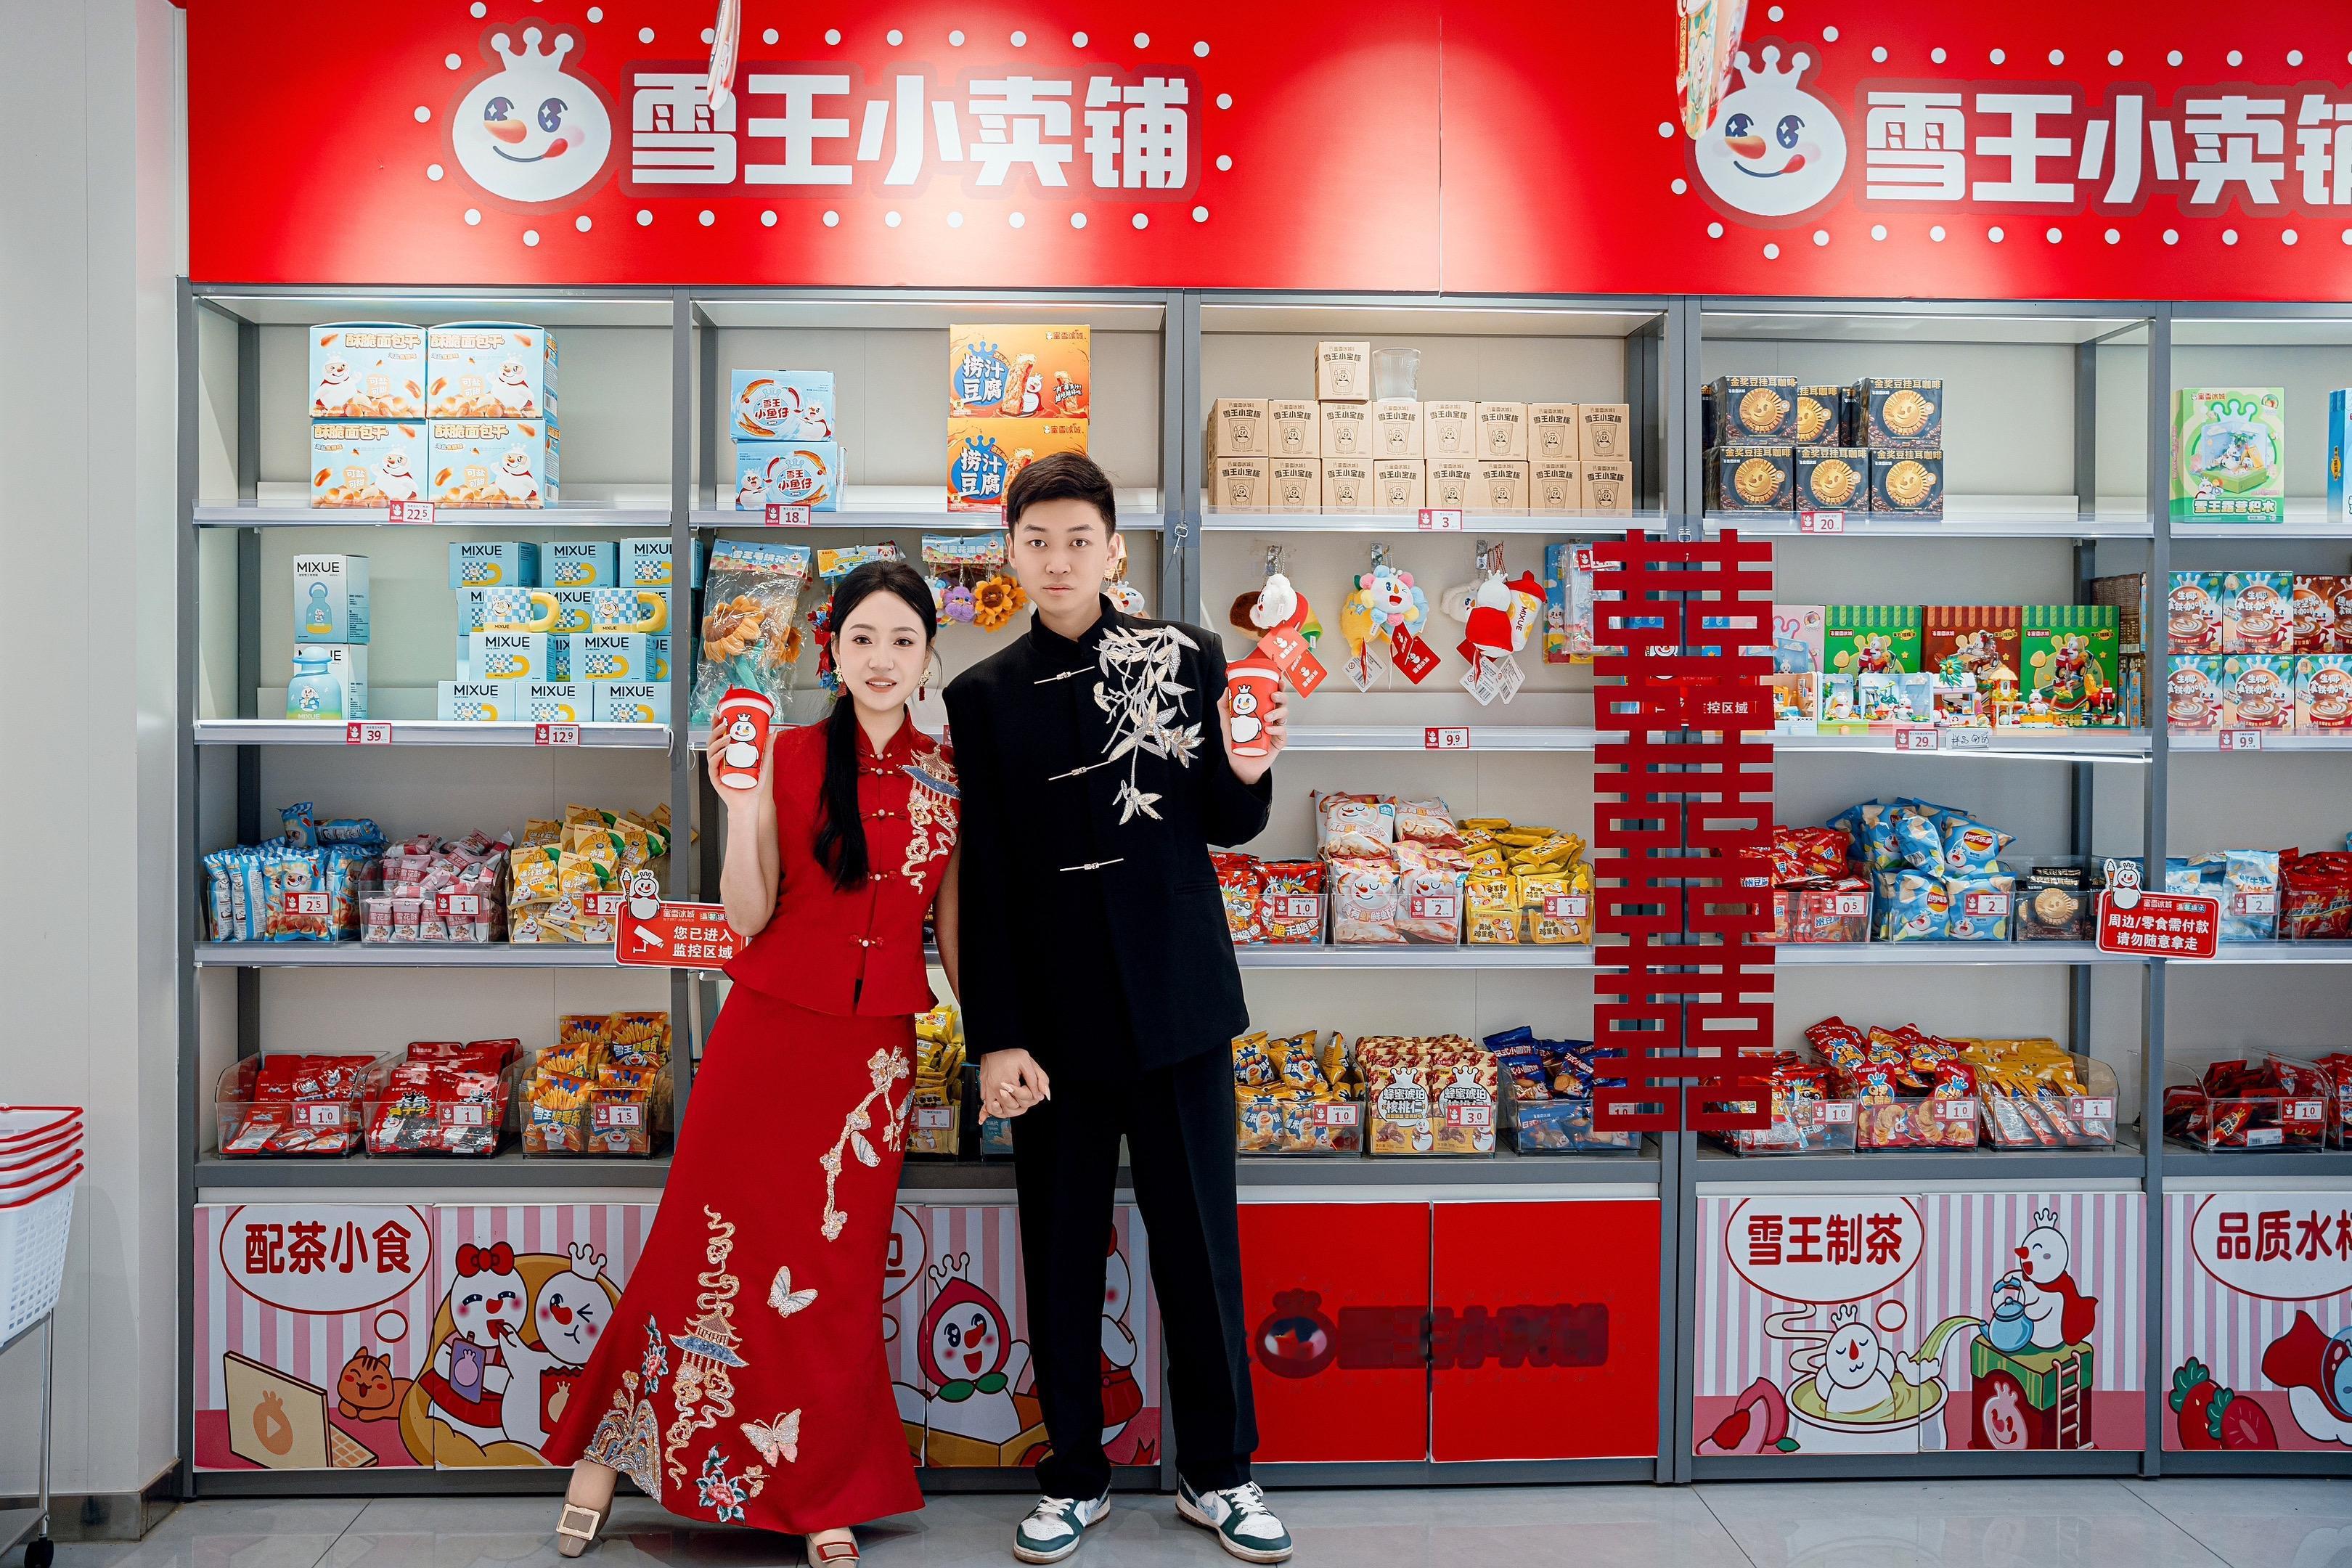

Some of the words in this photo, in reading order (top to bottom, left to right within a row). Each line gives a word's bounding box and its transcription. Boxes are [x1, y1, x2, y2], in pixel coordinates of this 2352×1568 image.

[632, 73, 1189, 189] 雪王小卖铺
[963, 353, 1005, 379] 捞汁
[1730, 377, 1797, 387] 金奖豆挂耳咖啡
[1874, 380, 1941, 390] 金奖豆挂耳咖啡
[963, 378, 1003, 404] 豆腐
[1797, 387, 1837, 396] 挂耳咖啡
[755, 408, 789, 420] 小鱼仔
[314, 425, 389, 440] 酥脆面包干
[434, 424, 508, 440] 酥脆面包干
[1726, 448, 1791, 457] 金奖豆挂耳咖啡
[1801, 449, 1867, 458] 金奖豆挂耳咖啡
[1877, 450, 1942, 460] 金奖豆挂耳咖啡
[961, 446, 1003, 473] 捞汁
[778, 478, 812, 491] 小鱼仔
[959, 473, 1001, 499] 豆腐
[2194, 500, 2275, 514] 雪王露营积木
[407, 509, 428, 520] 22.5
[785, 512, 799, 523] 18
[1442, 517, 1449, 528] 3
[1821, 519, 1834, 530] 20
[462, 545, 502, 556] MIXUE
[555, 545, 596, 556] MIXUE
[634, 544, 672, 555] MIXU
[297, 562, 340, 573] MIXUE
[2178, 592, 2197, 601] 生椰
[2247, 591, 2267, 601] 生椰
[1516, 606, 1527, 631] MIXUE
[486, 637, 530, 648] MIXUE
[585, 637, 629, 648] MIXUE
[2176, 674, 2197, 684] 生椰
[2247, 674, 2268, 684] 生椰
[2320, 674, 2340, 684] 生椰
[454, 685, 498, 696] MIXUE
[531, 685, 576, 697] MIXUE
[611, 686, 654, 698] MIXUE
[367, 730, 381, 741] 39
[552, 732, 573, 743] 12.9
[1446, 734, 1461, 746] 9.9
[1916, 737, 1928, 747] 29
[2240, 738, 2253, 747] 9.9
[590, 849, 606, 858] 水果
[306, 901, 321, 912] 2.5
[461, 902, 467, 912] 1
[1296, 905, 1310, 915] 1.0
[1434, 905, 1441, 915] 2
[1568, 904, 1574, 915] 1
[1843, 902, 1857, 912] 0.5
[1988, 902, 1995, 912] 2
[2144, 899, 2172, 910] 蜜雪冰城
[2256, 901, 2263, 911] 2
[663, 909, 695, 918] 蜜雪冰城
[2108, 913, 2210, 935] 周边/零食需付款
[674, 926, 734, 942] 您已进入
[1474, 931, 1495, 939] 鸡蛋卷
[1538, 928, 1561, 936] 鸡蛋卷
[2116, 931, 2198, 951] 请勿随意拿走
[672, 944, 733, 960] 监控区域
[1383, 1088, 1425, 1100] 蜂蜜琥珀
[1444, 1088, 1487, 1100] 蜂蜜琥珀
[1387, 1101, 1423, 1113] 核桃仁
[1954, 1107, 1967, 1117] 1.0
[2094, 1106, 2099, 1116] 1
[2303, 1107, 2314, 1117] 1.0
[319, 1112, 333, 1123] 1.0
[465, 1112, 470, 1122] 1
[618, 1113, 631, 1123] 1.5
[931, 1115, 937, 1124] 1
[1336, 1112, 1349, 1122] 1.0
[1468, 1113, 1482, 1123] 3.0
[1833, 1110, 1845, 1120] 1.0
[1747, 1213, 1902, 1265] 雪王制茶
[245, 1220, 412, 1274] 配茶小食
